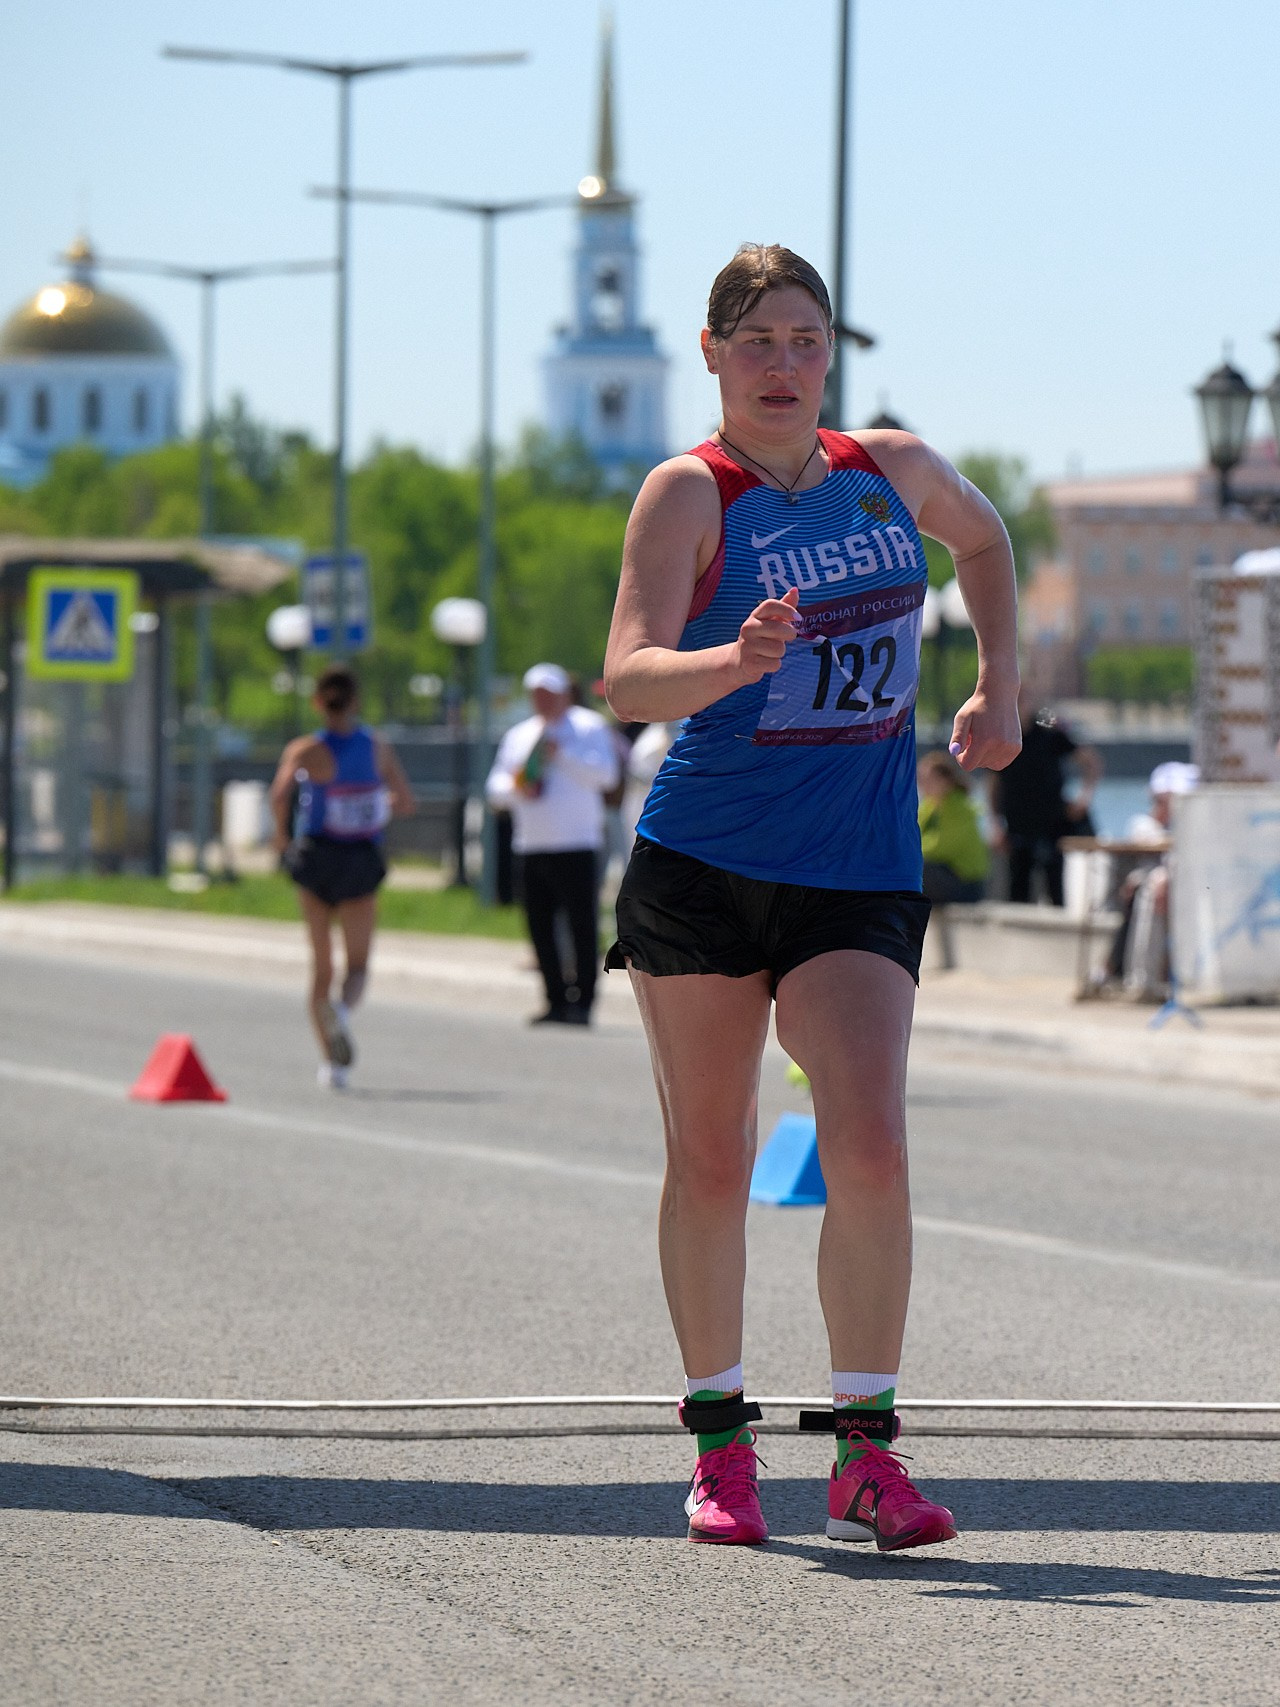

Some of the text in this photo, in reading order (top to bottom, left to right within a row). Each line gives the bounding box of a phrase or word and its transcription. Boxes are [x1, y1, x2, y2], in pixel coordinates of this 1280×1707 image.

[756, 526, 918, 598] RUSSIA
[789, 594, 915, 627] МПИОНАТ РОССИИ
[812, 636, 896, 712] 122
[834, 1392, 878, 1406] SPORT
